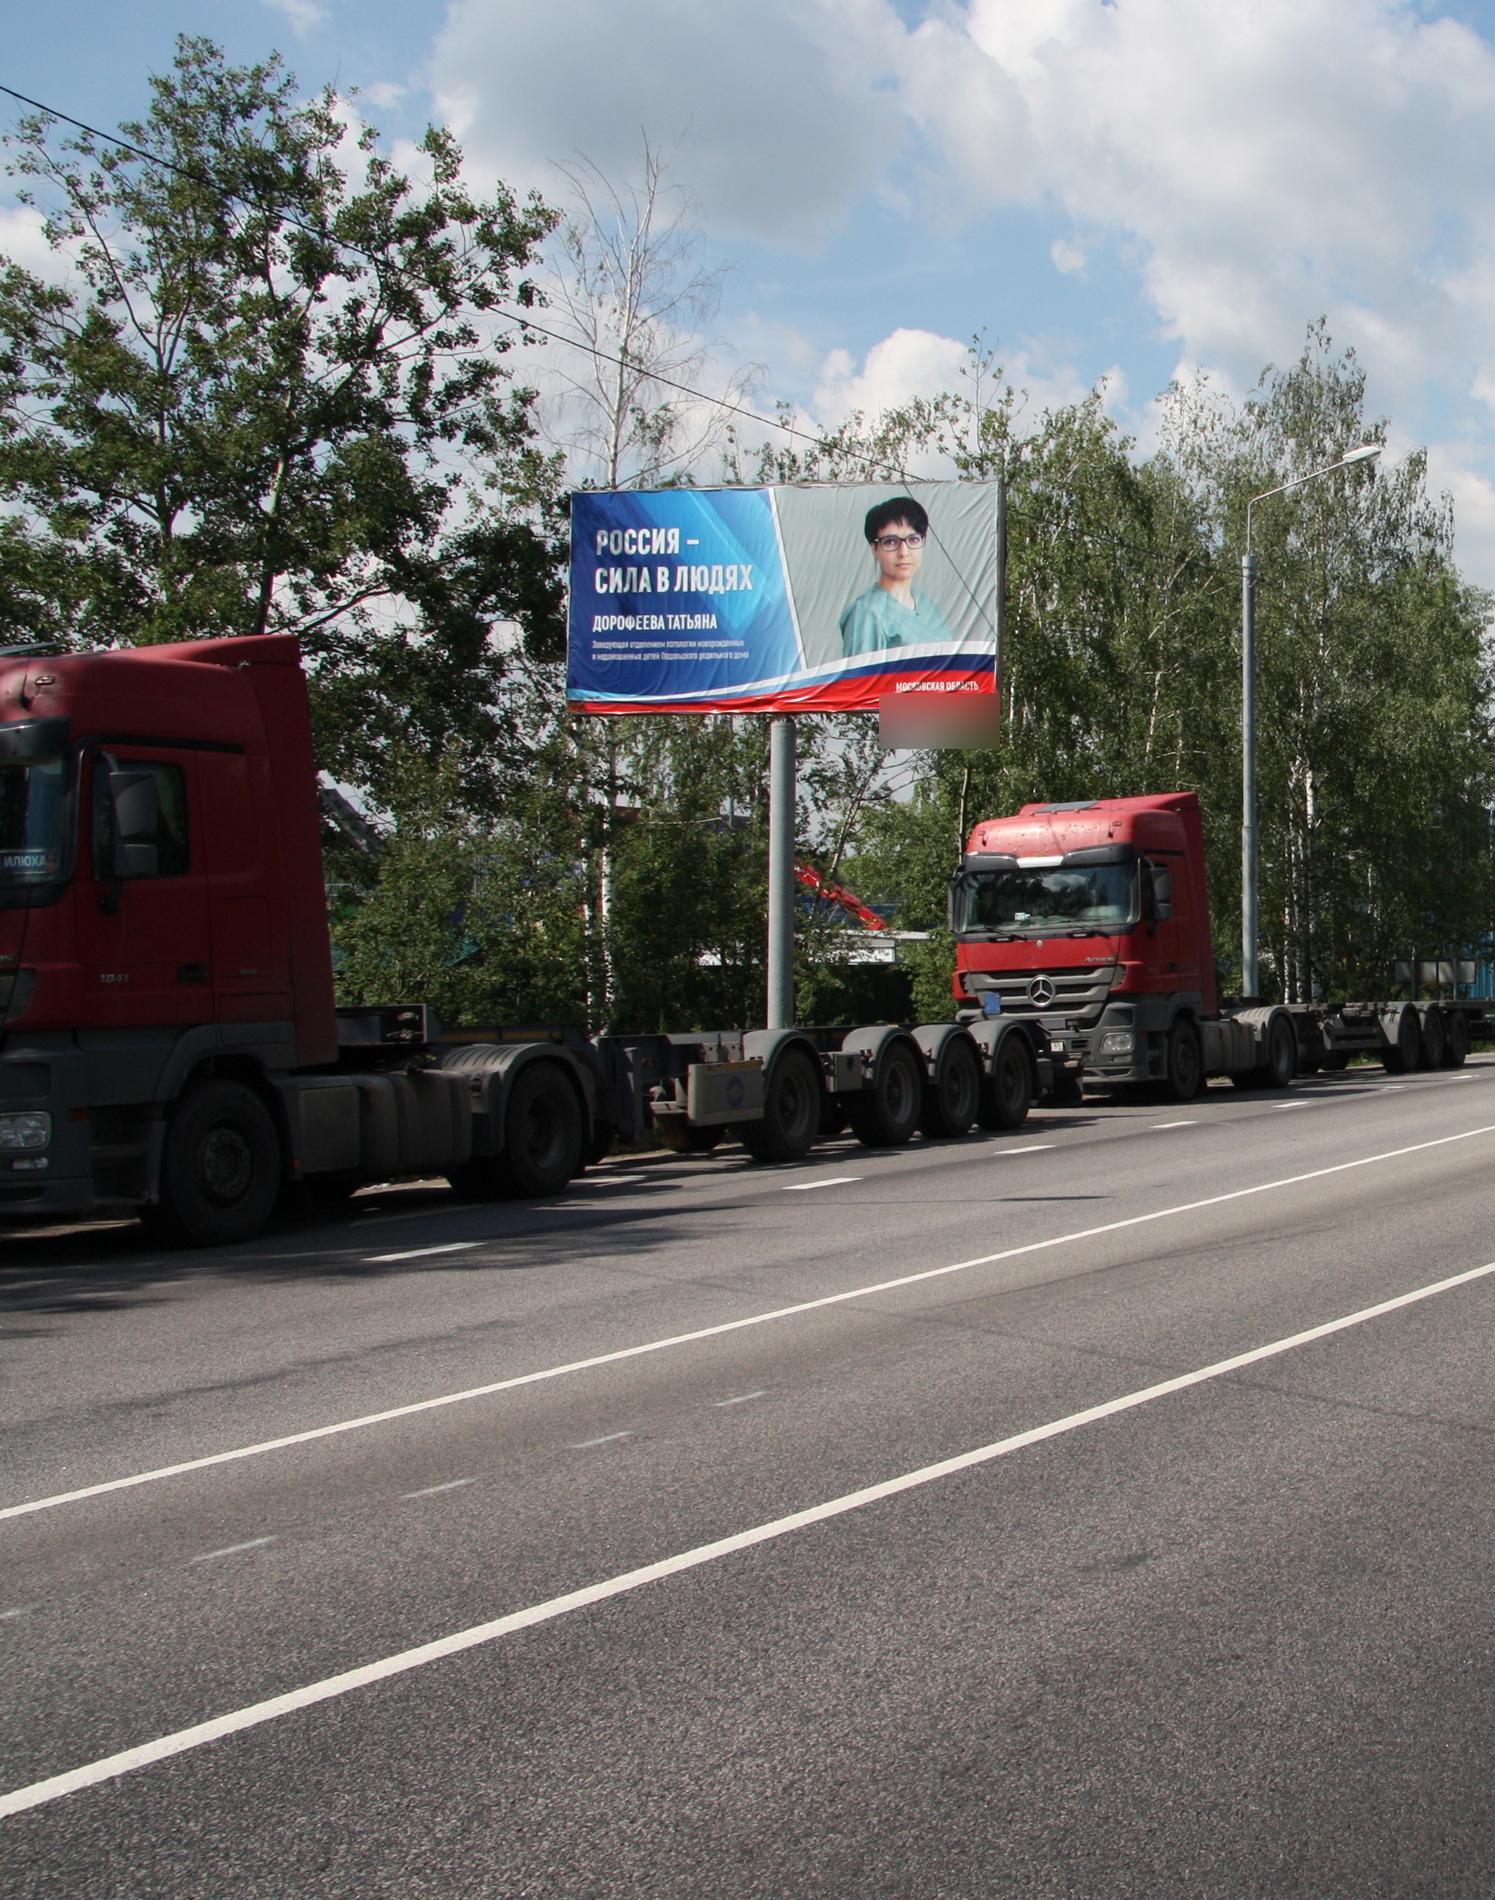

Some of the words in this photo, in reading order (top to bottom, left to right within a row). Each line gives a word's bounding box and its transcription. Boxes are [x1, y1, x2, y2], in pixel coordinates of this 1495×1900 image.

[596, 528, 680, 555] РОССИЯ
[595, 566, 652, 594] СИЛА
[657, 566, 670, 593] В
[674, 564, 753, 595] ЛЮДЯХ
[592, 614, 665, 632] ДОРОФЕЕВА
[666, 613, 717, 631] ТАТЬЯНА
[896, 681, 945, 692] МОСКОВСКАЯ
[946, 681, 979, 692] ОБЛАСТЬ
